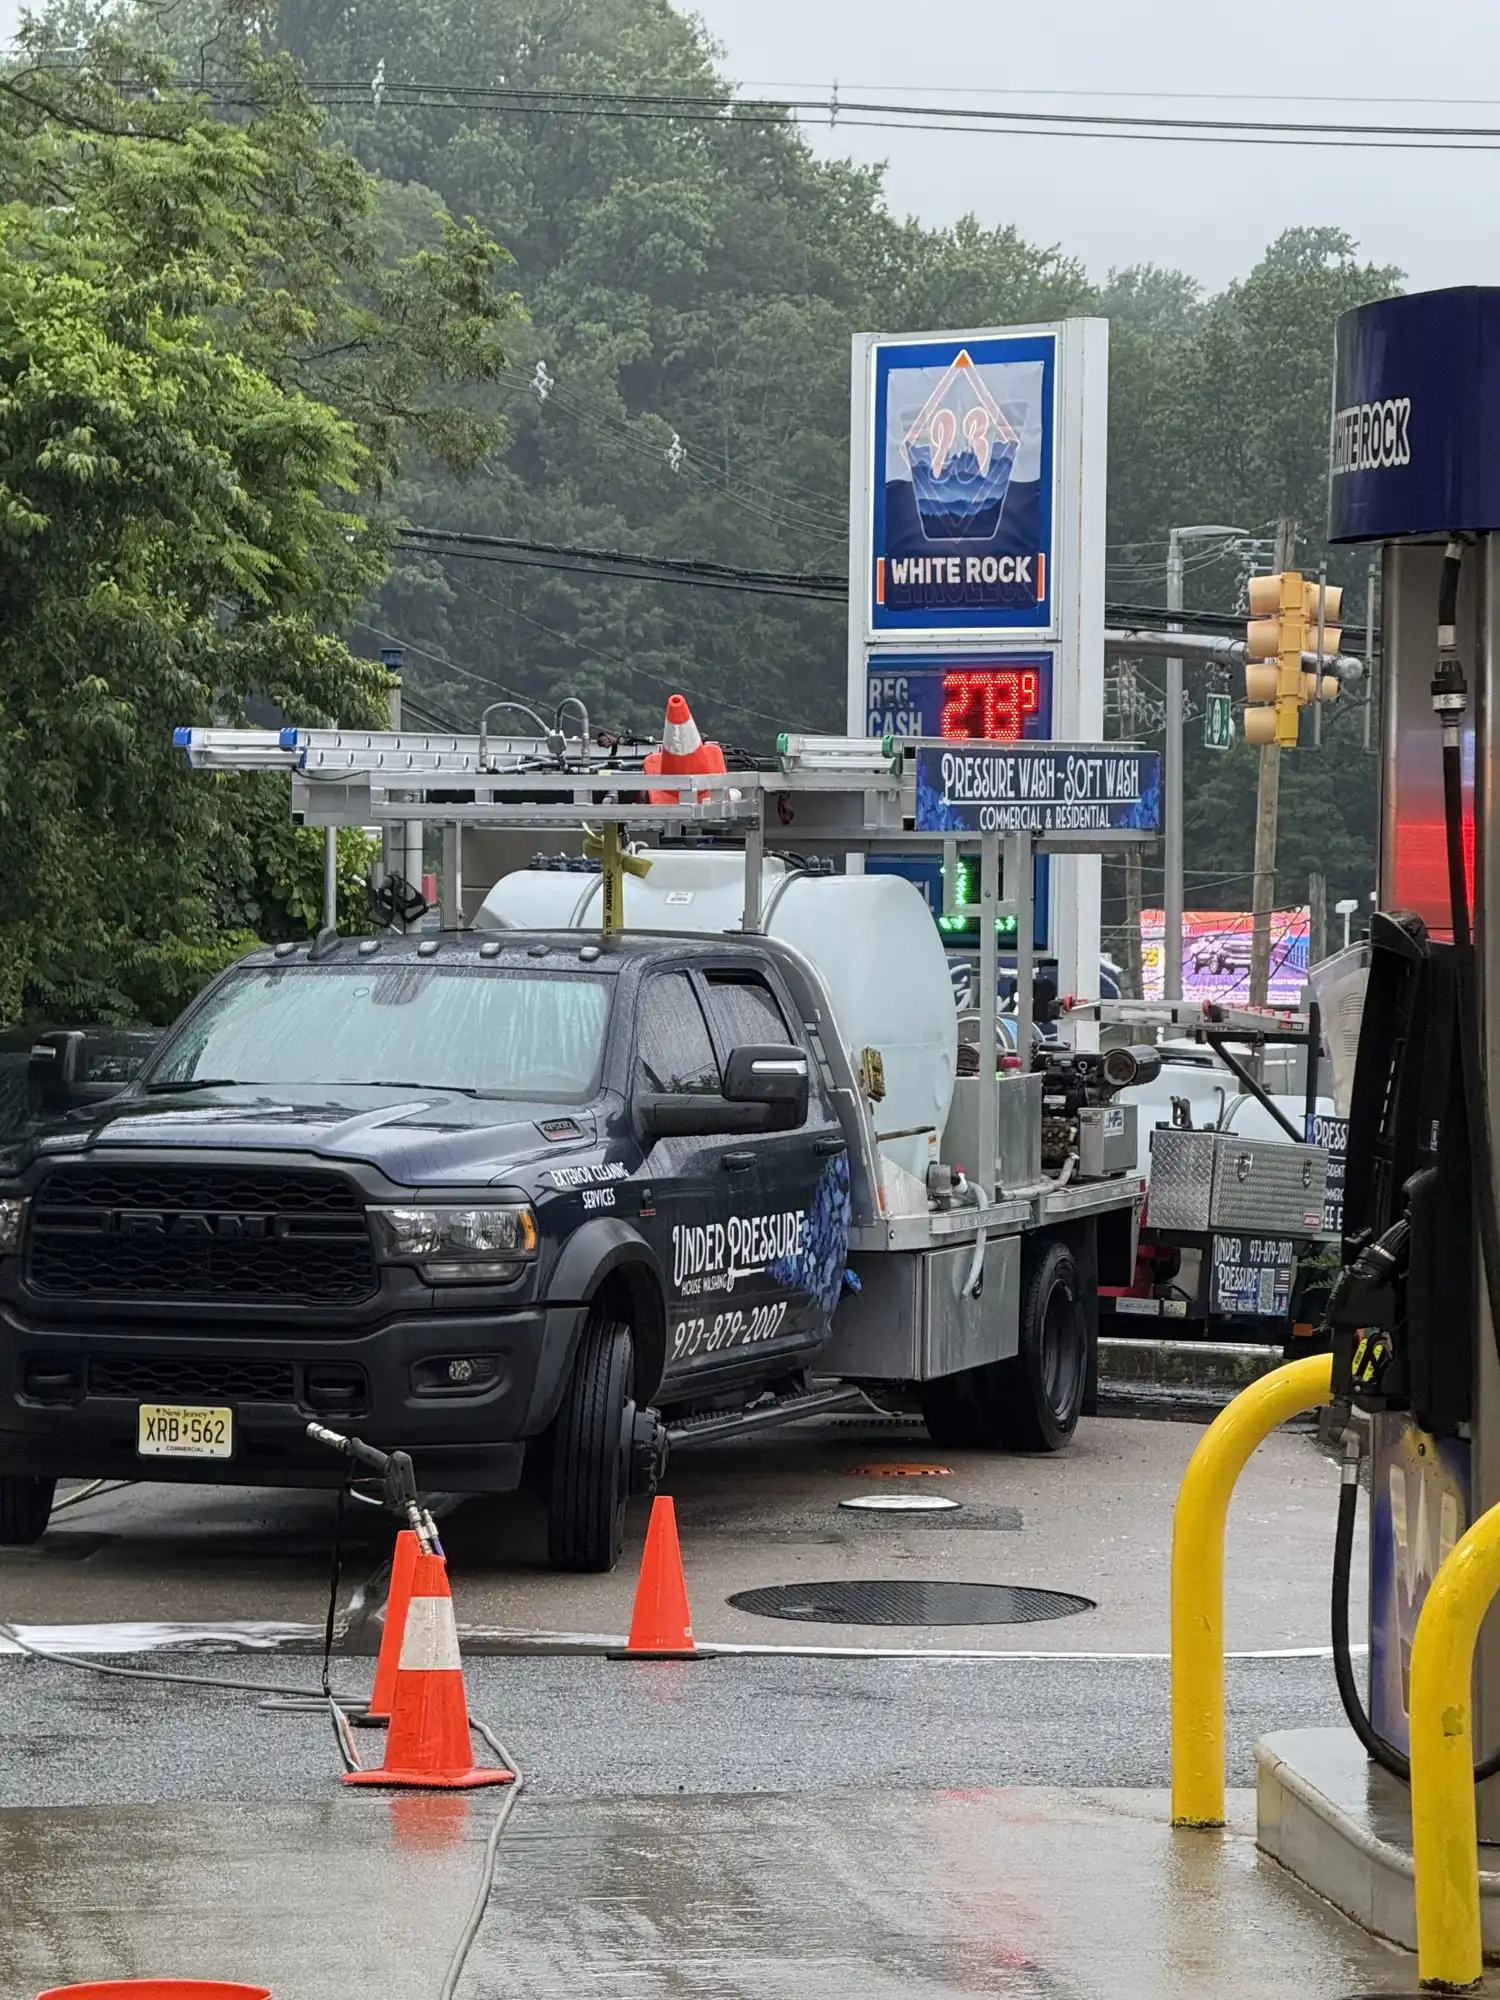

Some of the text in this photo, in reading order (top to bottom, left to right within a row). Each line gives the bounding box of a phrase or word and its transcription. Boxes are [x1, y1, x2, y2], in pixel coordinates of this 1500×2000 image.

[1360, 397, 1411, 470] ROCK
[891, 556, 1032, 584] WHITE ROCK
[868, 711, 922, 738] CASH
[941, 753, 1014, 799] PRESSURE
[1104, 760, 1139, 797] WASH
[979, 805, 1111, 830] COMMERCIAL & RESIDENTIAL
[1313, 1117, 1350, 1151] PRESS
[550, 1162, 630, 1187] EXTERIOR CLEANING
[582, 1188, 615, 1209] SERVICES
[120, 1212, 266, 1239] RAM
[672, 1210, 805, 1287] UNDER PRESSURE
[1213, 1234, 1242, 1267] UNDER
[681, 1273, 728, 1297] HOUSE WASHING
[1217, 1263, 1259, 1292] PRESSURE
[671, 1301, 788, 1361] 973-879-2007
[162, 1408, 209, 1419] New Jersey
[146, 1417, 179, 1442] XRB
[165, 1445, 204, 1453] COMMERCIAL
